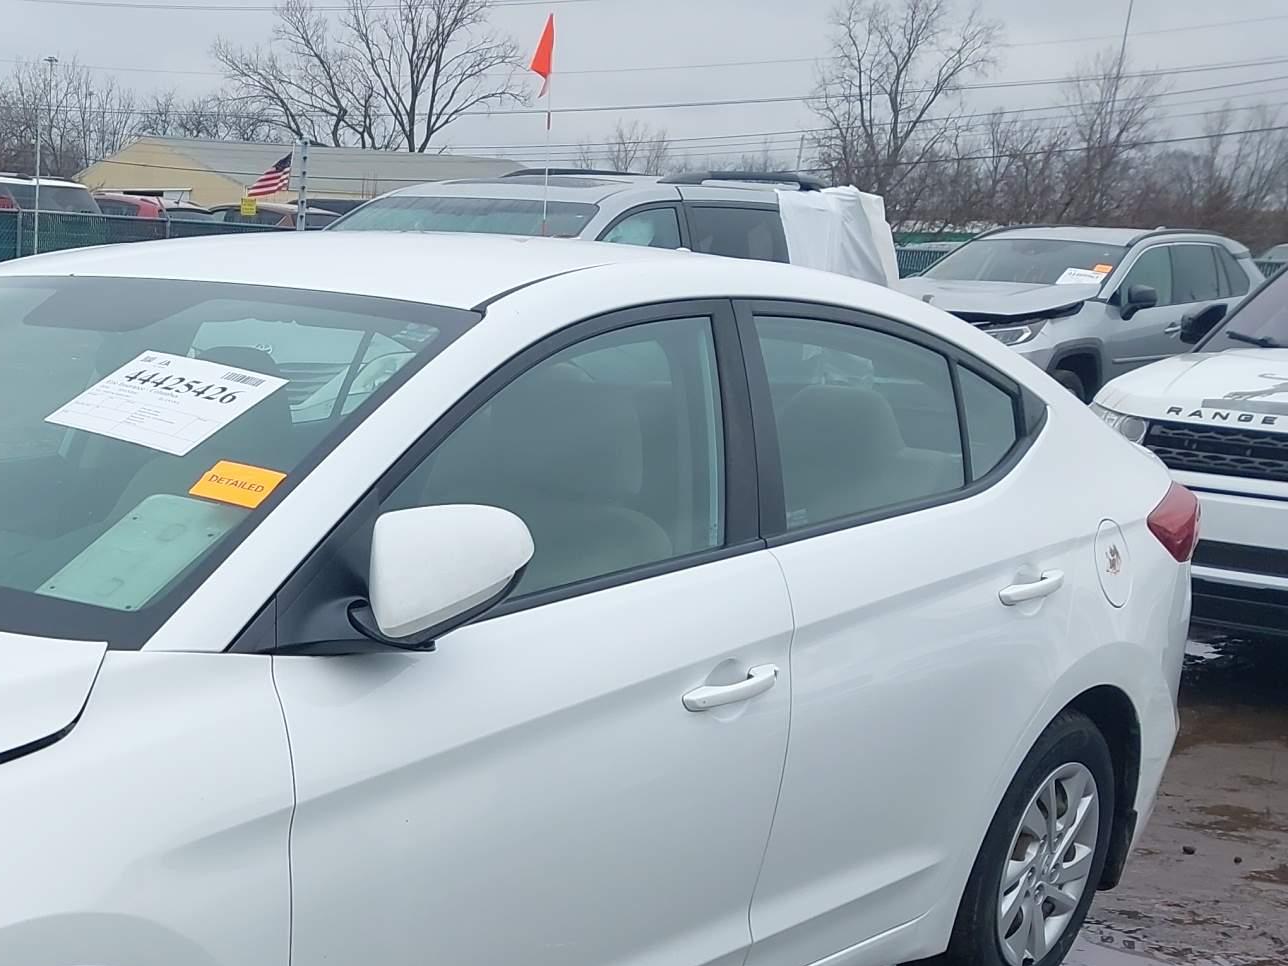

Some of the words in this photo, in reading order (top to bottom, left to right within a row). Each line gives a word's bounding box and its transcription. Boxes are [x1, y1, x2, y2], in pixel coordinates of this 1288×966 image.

[125, 369, 244, 404] 44425426
[1166, 406, 1279, 425] RANGE
[208, 474, 265, 493] DETAILED
